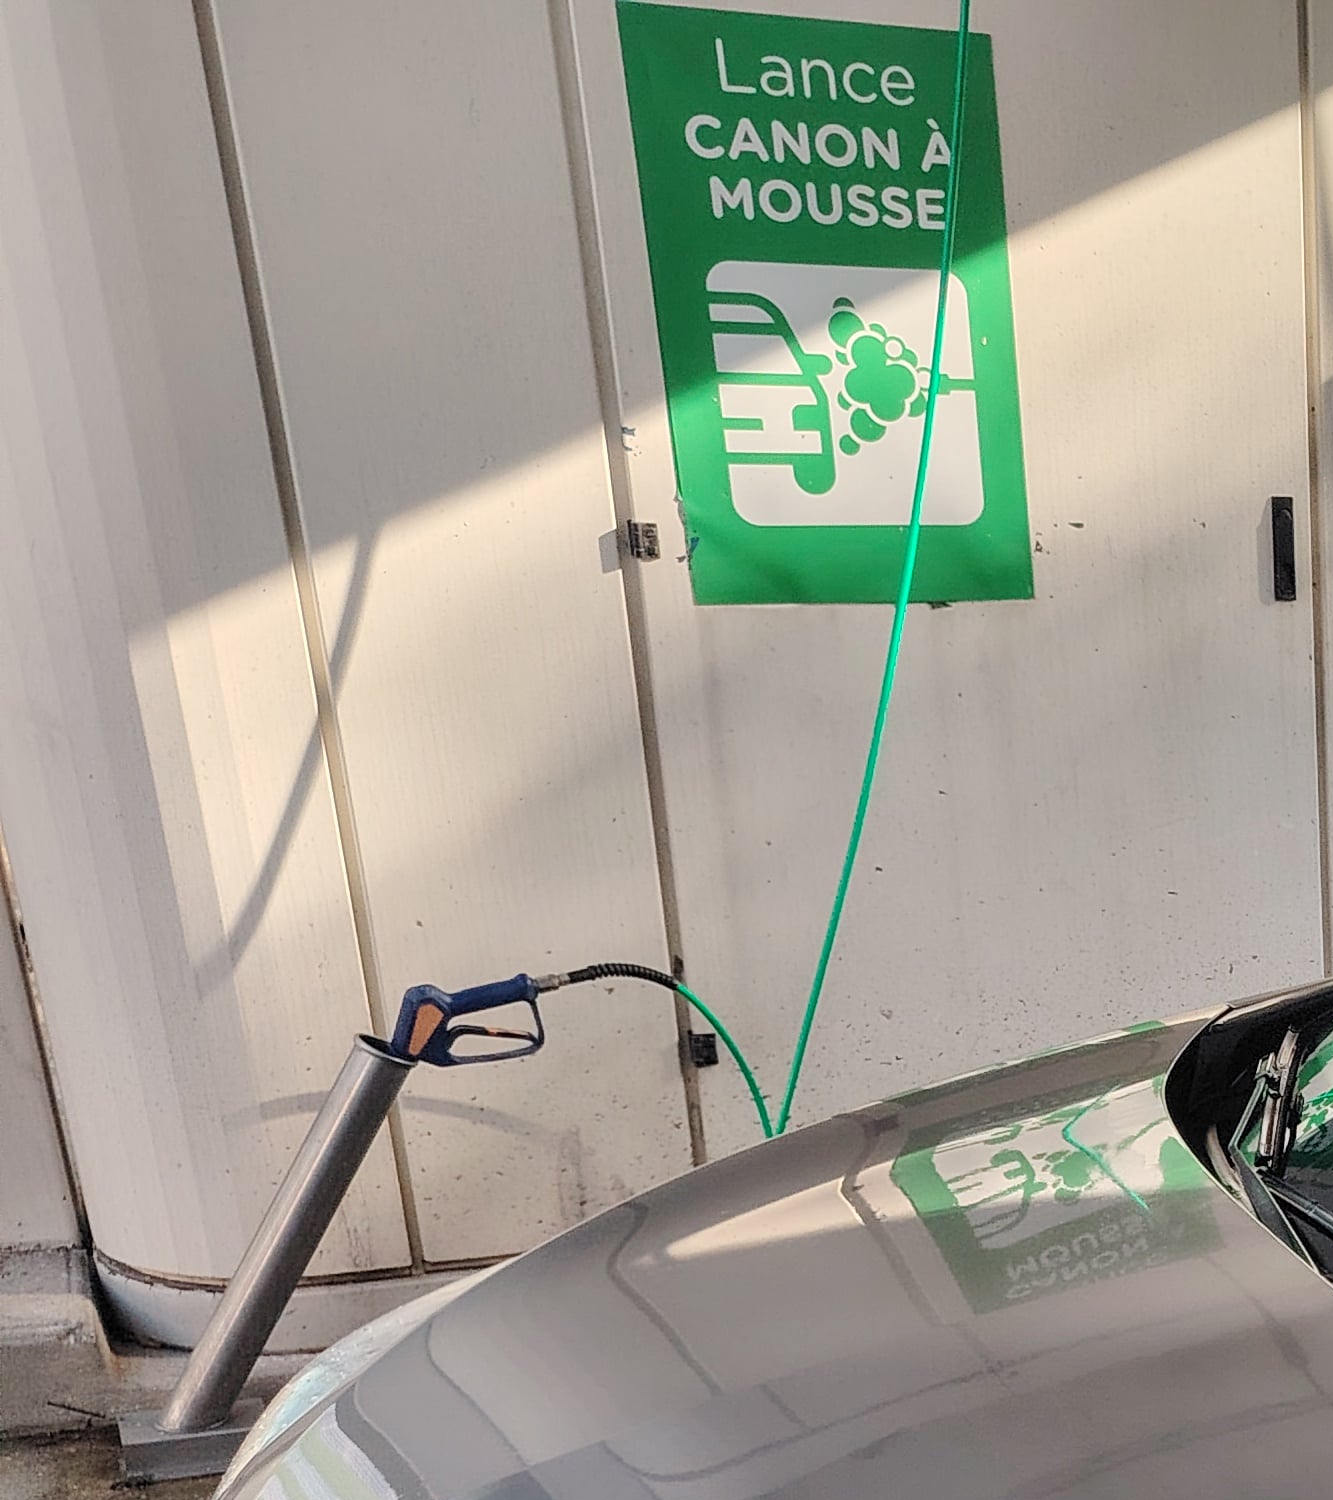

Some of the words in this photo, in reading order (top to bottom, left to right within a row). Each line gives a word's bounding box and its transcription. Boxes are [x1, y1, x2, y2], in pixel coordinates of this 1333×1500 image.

[714, 37, 916, 106] Lance
[684, 114, 901, 170] CANON
[921, 119, 951, 172] À
[708, 175, 947, 231] MOUSSE
